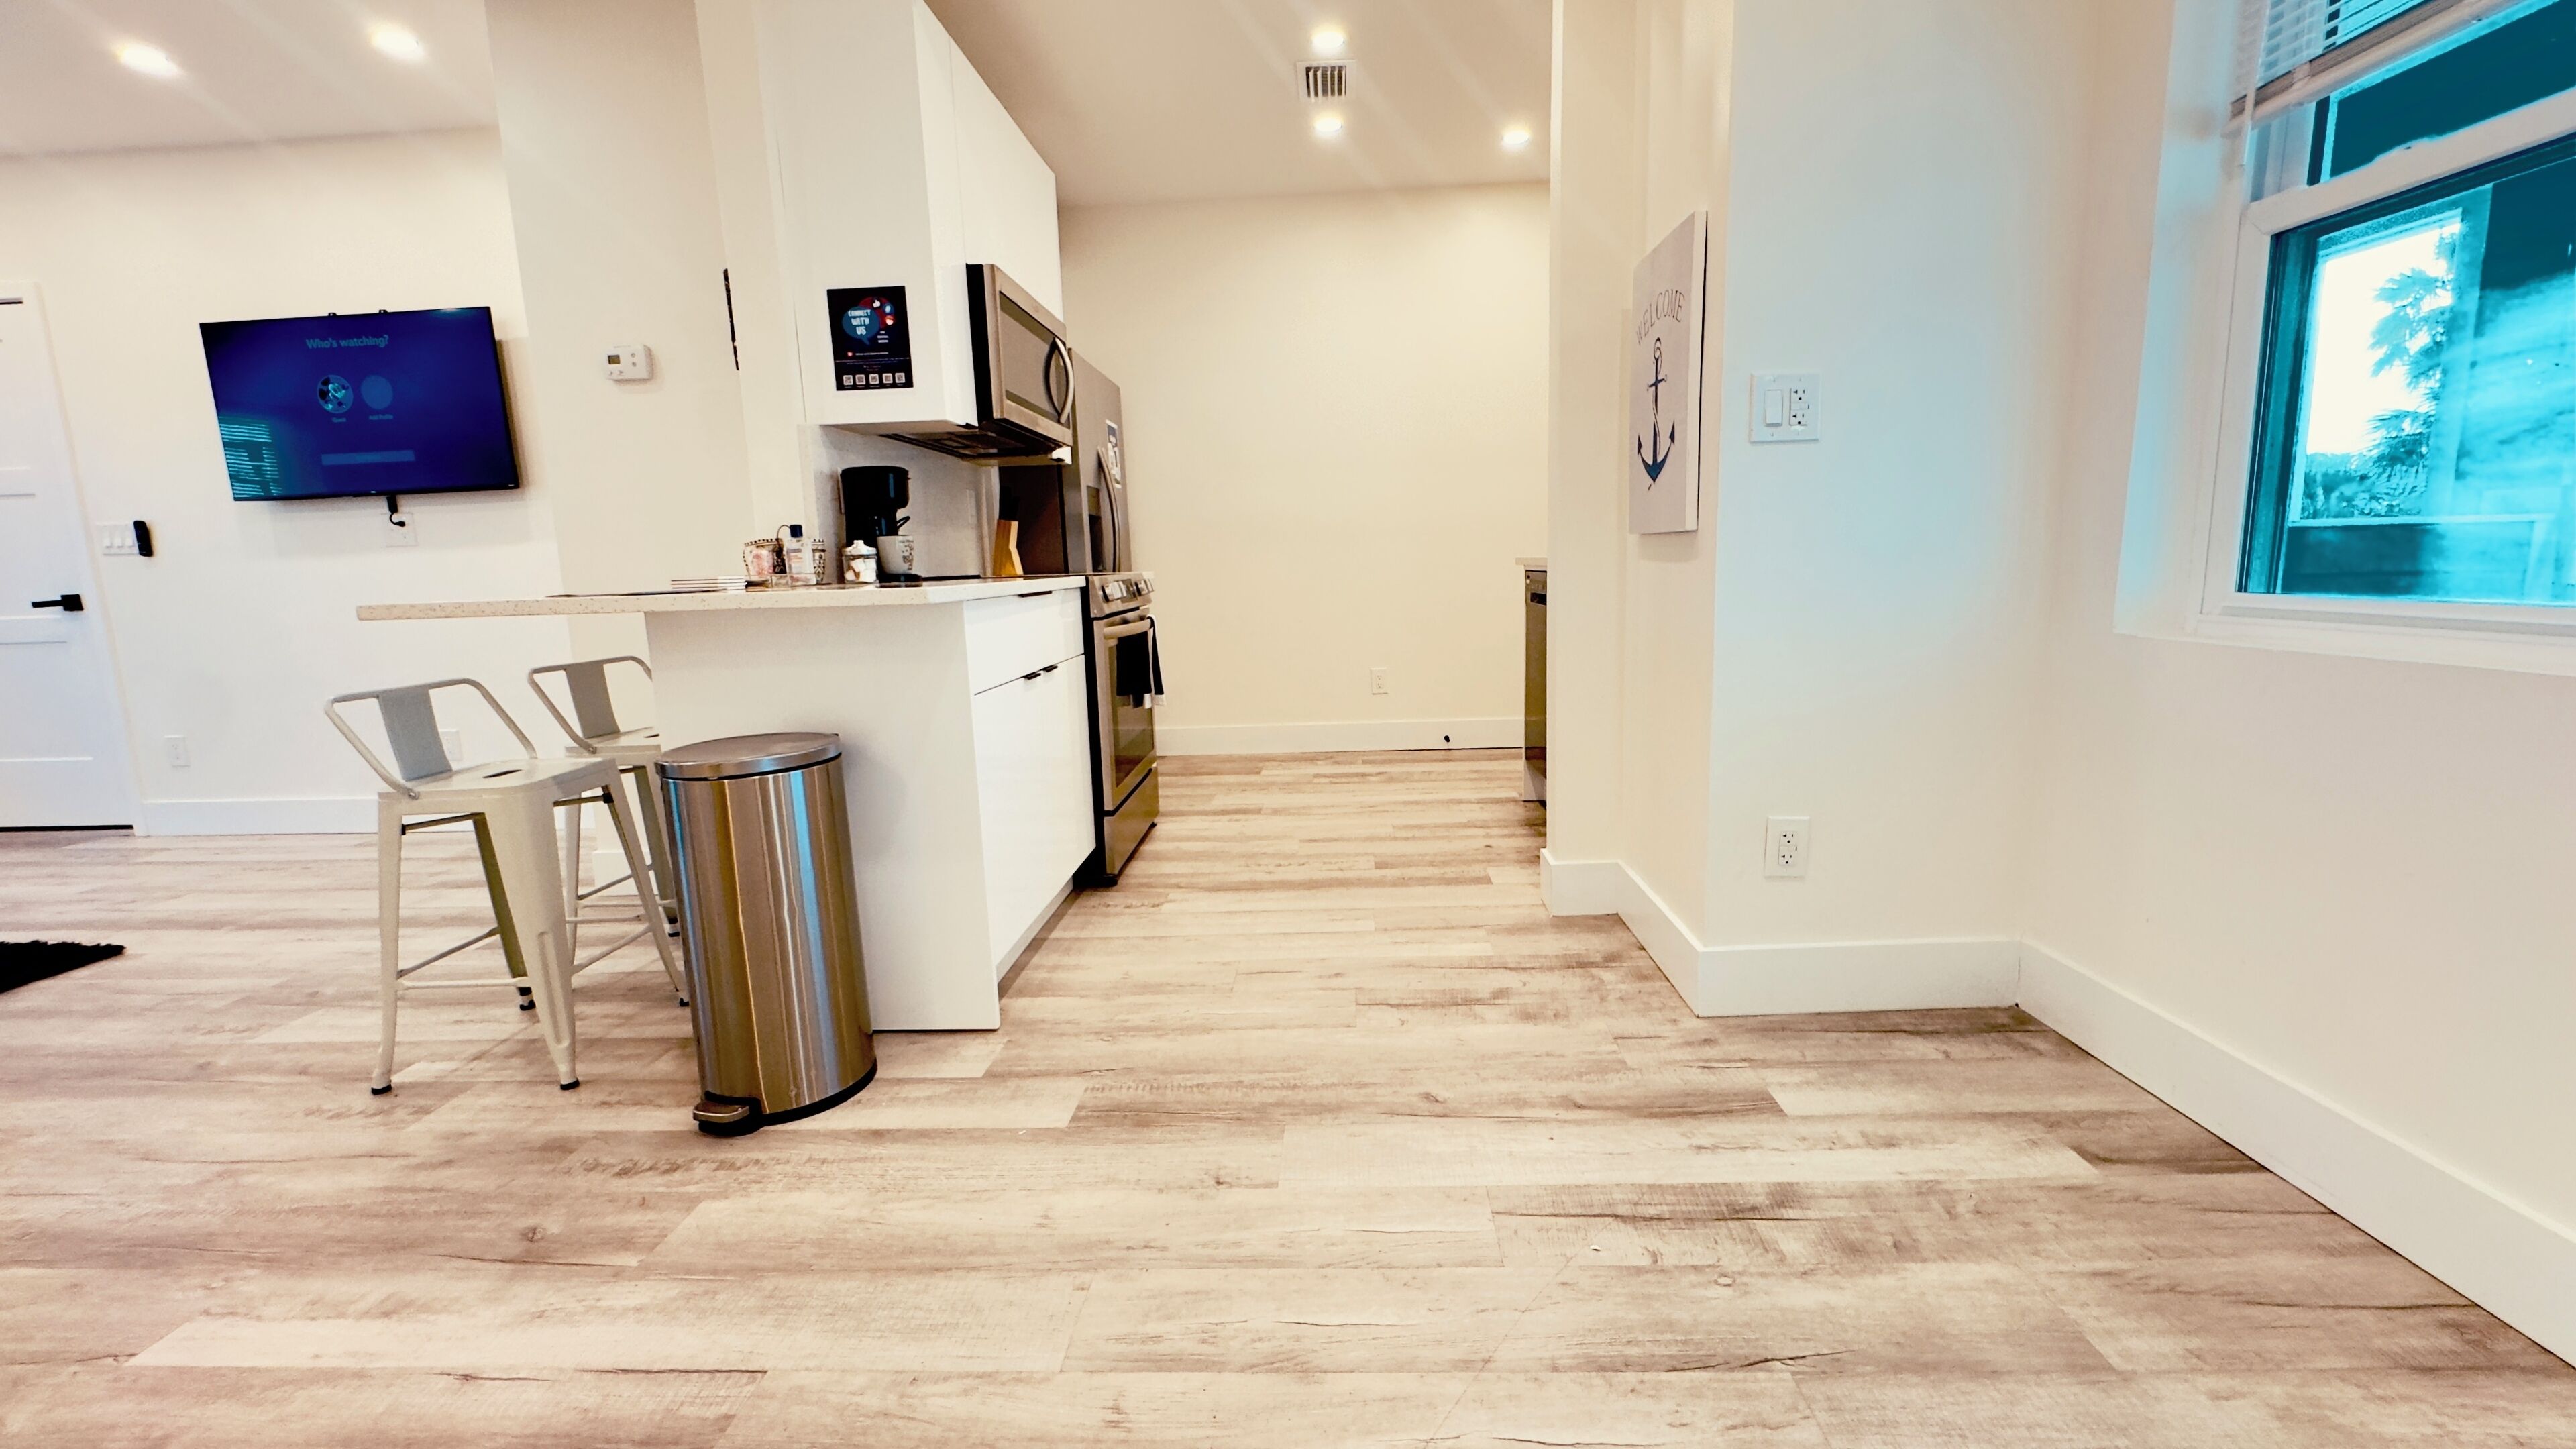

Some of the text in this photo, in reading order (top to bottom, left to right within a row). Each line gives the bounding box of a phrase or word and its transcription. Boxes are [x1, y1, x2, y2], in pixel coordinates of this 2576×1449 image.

[851, 317, 869, 325] WITH
[1636, 289, 1685, 345] WELCOME
[856, 326, 867, 335] US
[306, 335, 389, 349] Who's watching?
